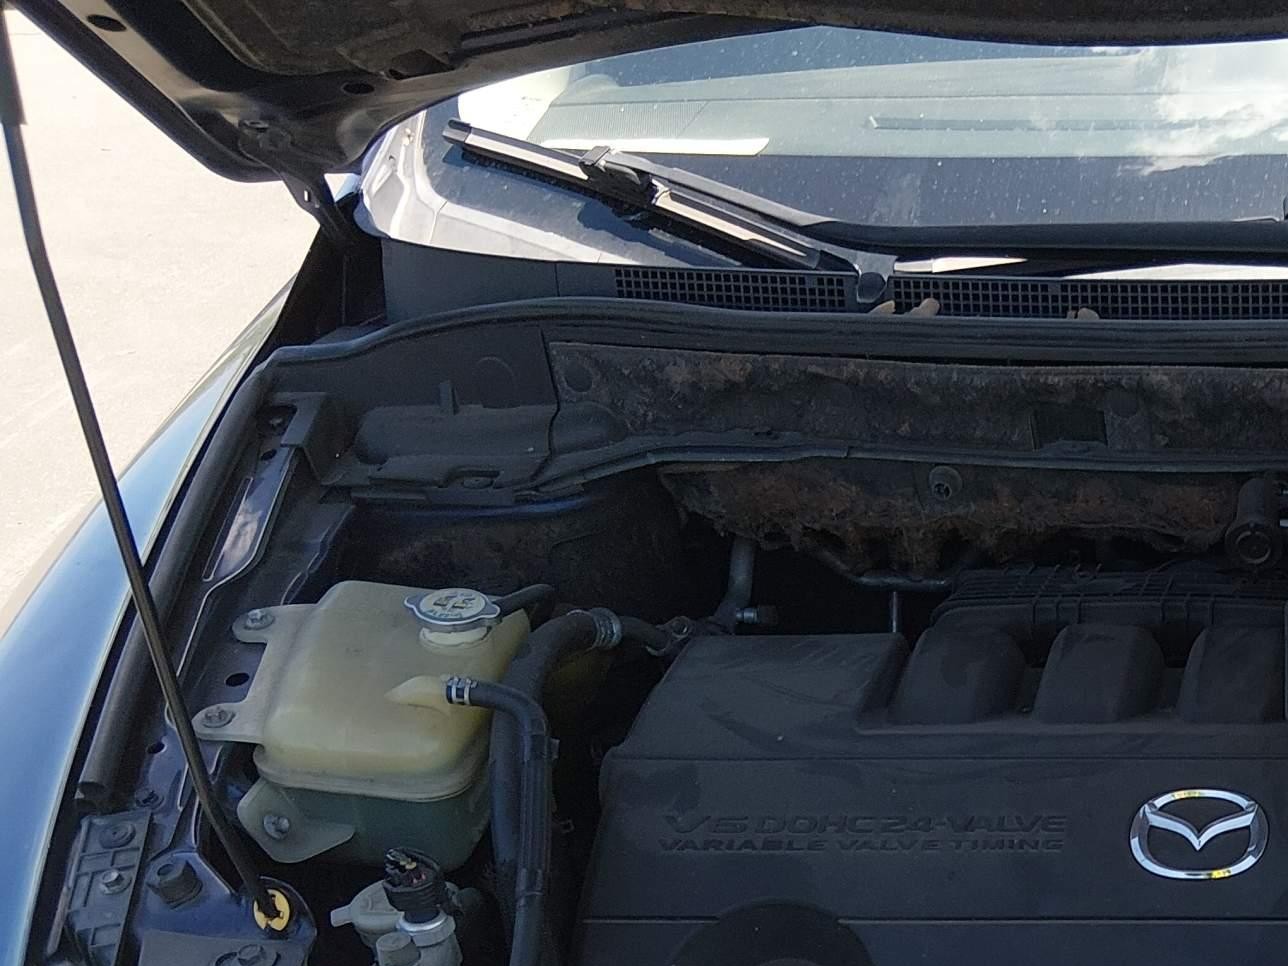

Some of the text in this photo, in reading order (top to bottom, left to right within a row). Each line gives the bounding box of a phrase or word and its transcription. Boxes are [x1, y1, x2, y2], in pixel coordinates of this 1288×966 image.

[754, 815, 874, 834] DOHC
[879, 815, 1067, 833] 24-VALVE
[657, 839, 1065, 851] VARIABLE VALVE TIMING
